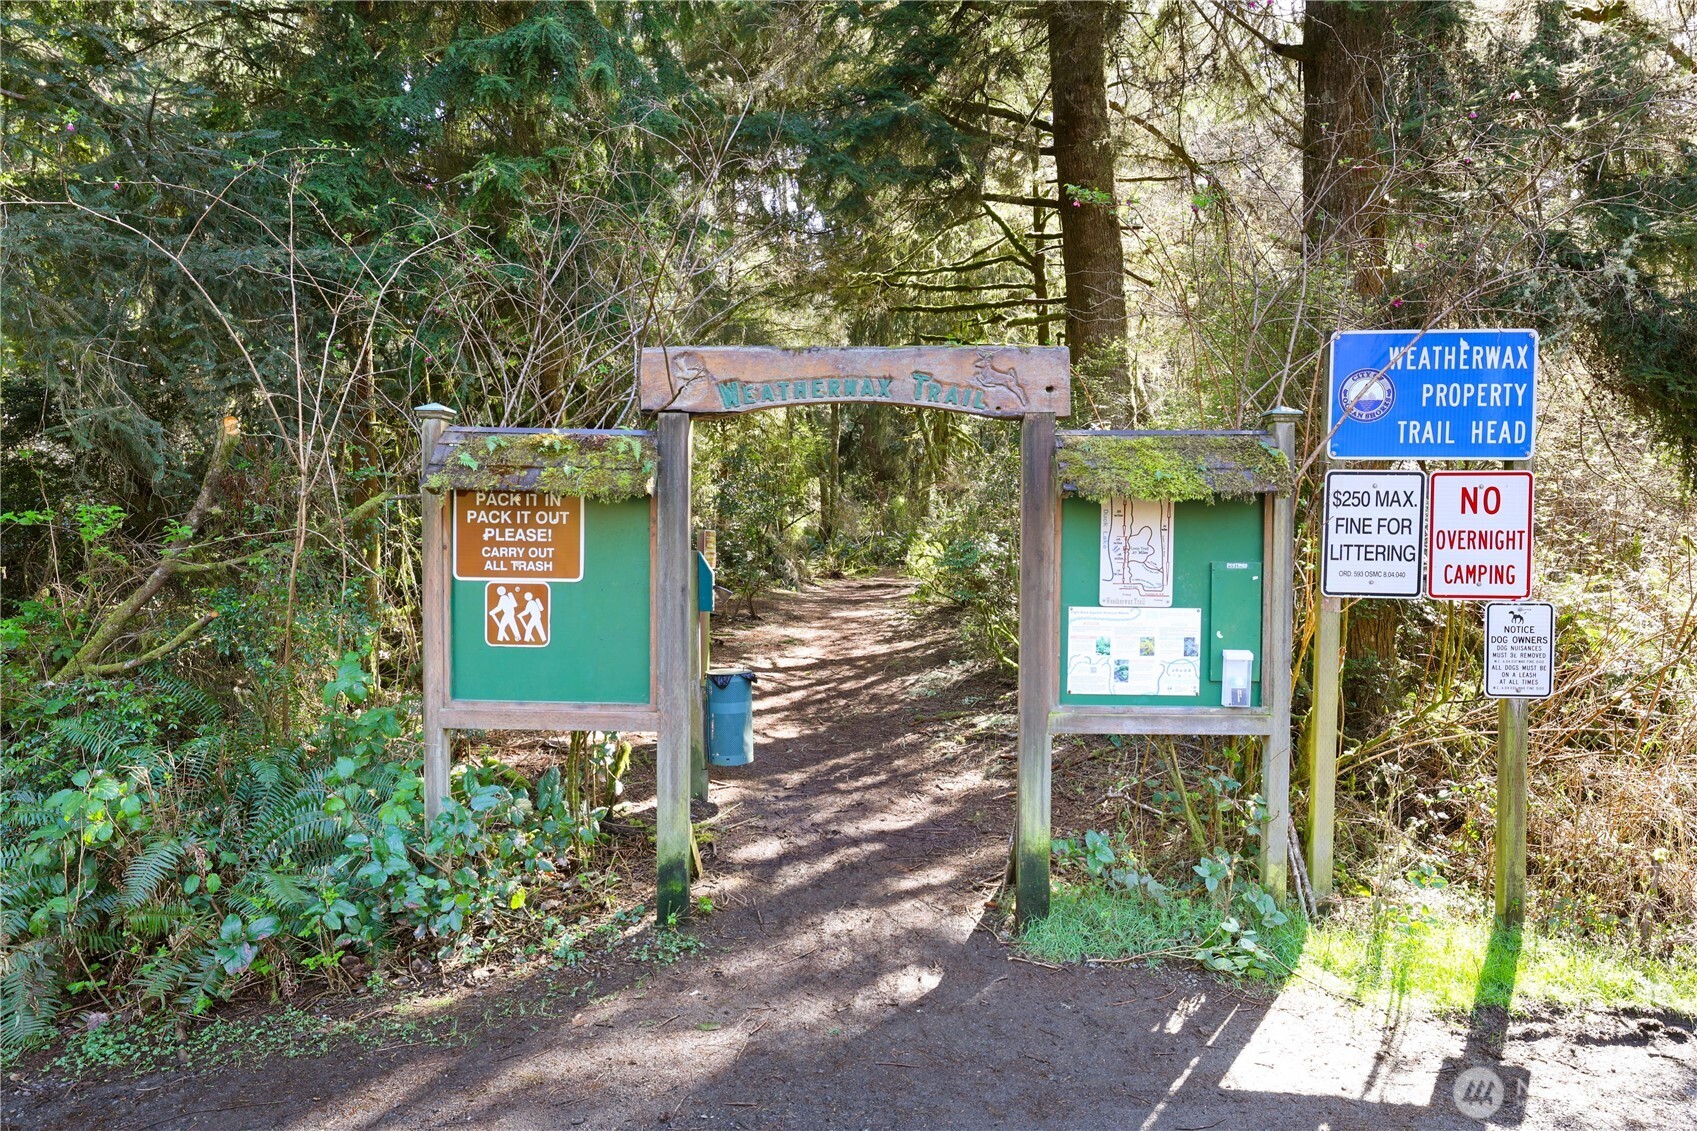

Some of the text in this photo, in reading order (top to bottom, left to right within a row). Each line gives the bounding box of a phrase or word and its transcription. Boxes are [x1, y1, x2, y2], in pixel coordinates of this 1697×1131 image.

[1389, 345, 1529, 370] WEATHERWAX
[1351, 371, 1371, 381] CITY
[718, 372, 986, 410] WEATHERWAX TRAIL
[1422, 383, 1527, 407] PROPERTY
[1364, 397, 1392, 419] SHORES
[1397, 420, 1527, 444] TRAIL HEAD
[475, 493, 561, 507] PACK IT IN
[1332, 489, 1418, 509] $250 MAX.
[1460, 486, 1501, 515] NO
[466, 510, 570, 525] PACK IT OUT
[1335, 517, 1412, 535] FINE FOR
[483, 528, 552, 542] PLEASE!
[1436, 529, 1526, 550] OVERNIGHT
[481, 546, 555, 558] CARRY OUT
[1330, 544, 1416, 562] LITTERING
[484, 560, 553, 572] ALL TRASH
[1354, 570, 1364, 578] 593
[1364, 570, 1382, 578] OSMC
[1444, 564, 1515, 585] CAMPING
[1503, 625, 1535, 634] NOTICE
[1491, 635, 1548, 644] DOG OWNERS
